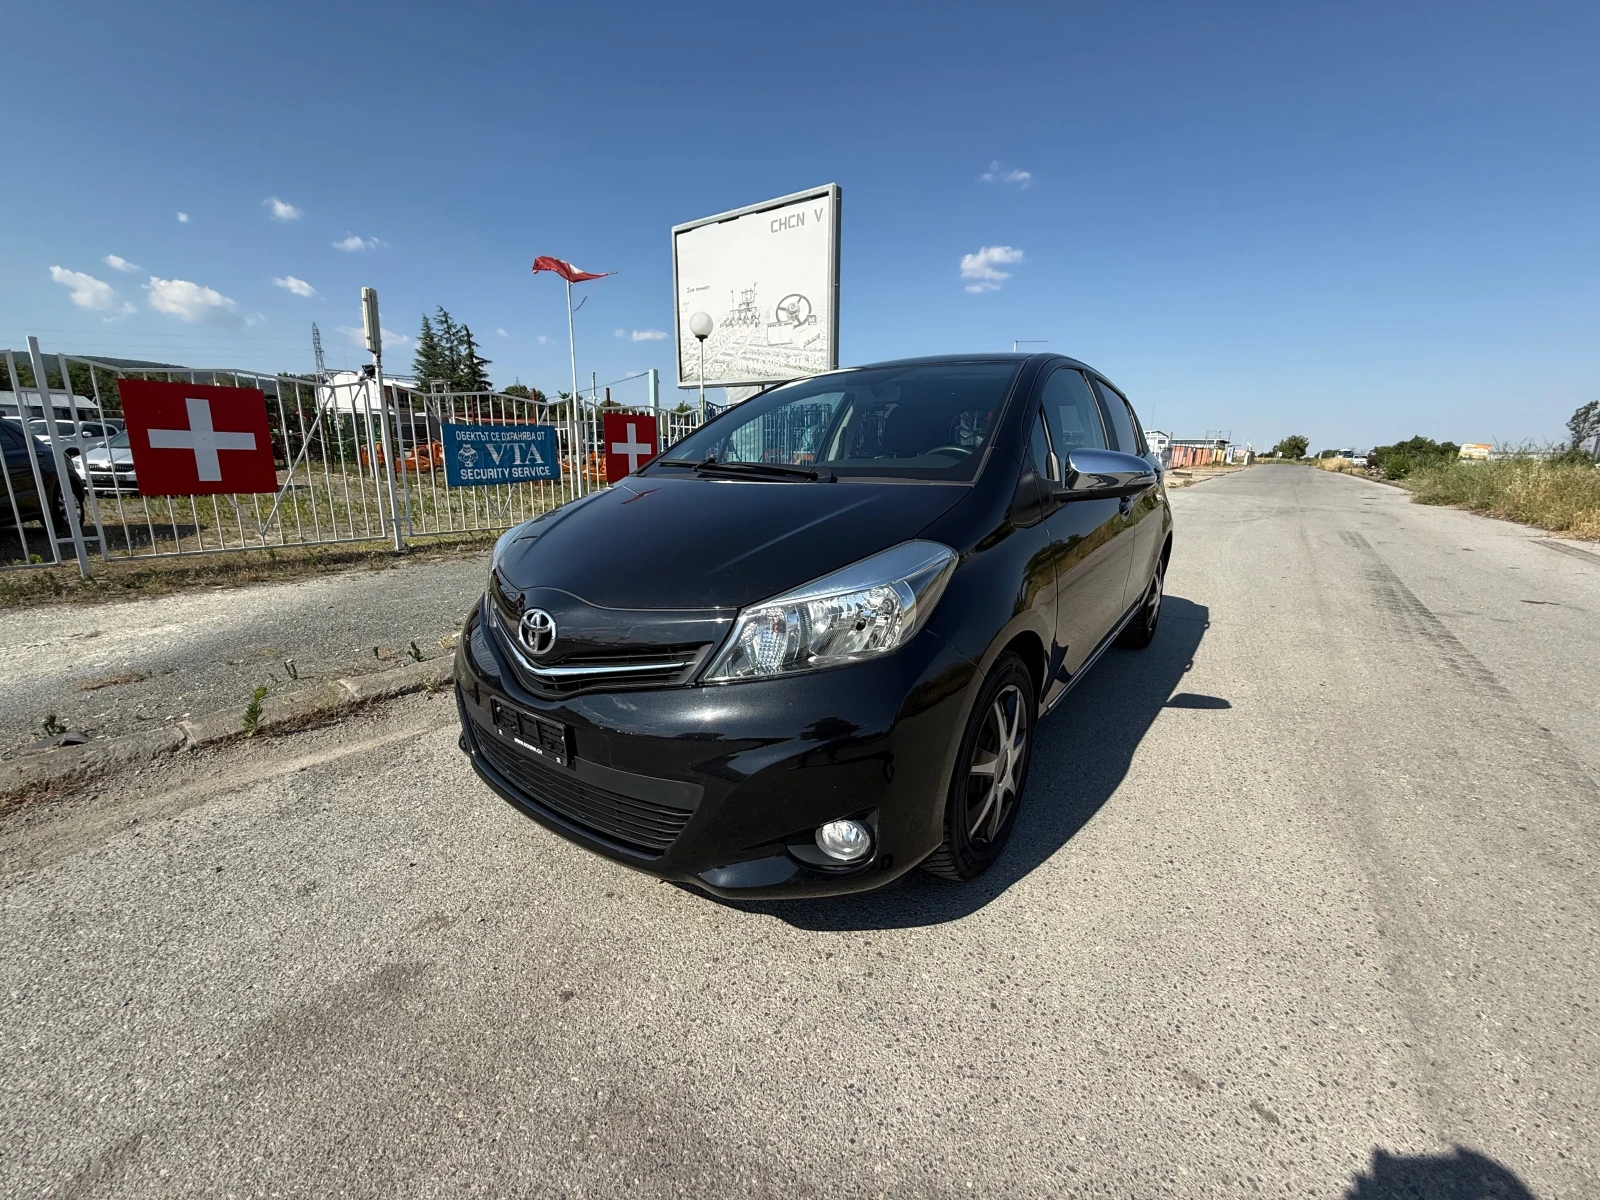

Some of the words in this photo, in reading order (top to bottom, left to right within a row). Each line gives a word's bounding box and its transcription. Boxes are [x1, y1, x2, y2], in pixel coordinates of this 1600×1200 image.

[455, 430, 489, 441] ОБЕКТЪТ
[490, 431, 500, 441] СЕ
[502, 431, 536, 441] ОХРАНЯВА
[537, 431, 545, 440] ОТ
[485, 442, 545, 465] VTA
[460, 467, 510, 480] SECURITY
[512, 466, 551, 478] SERVICE
